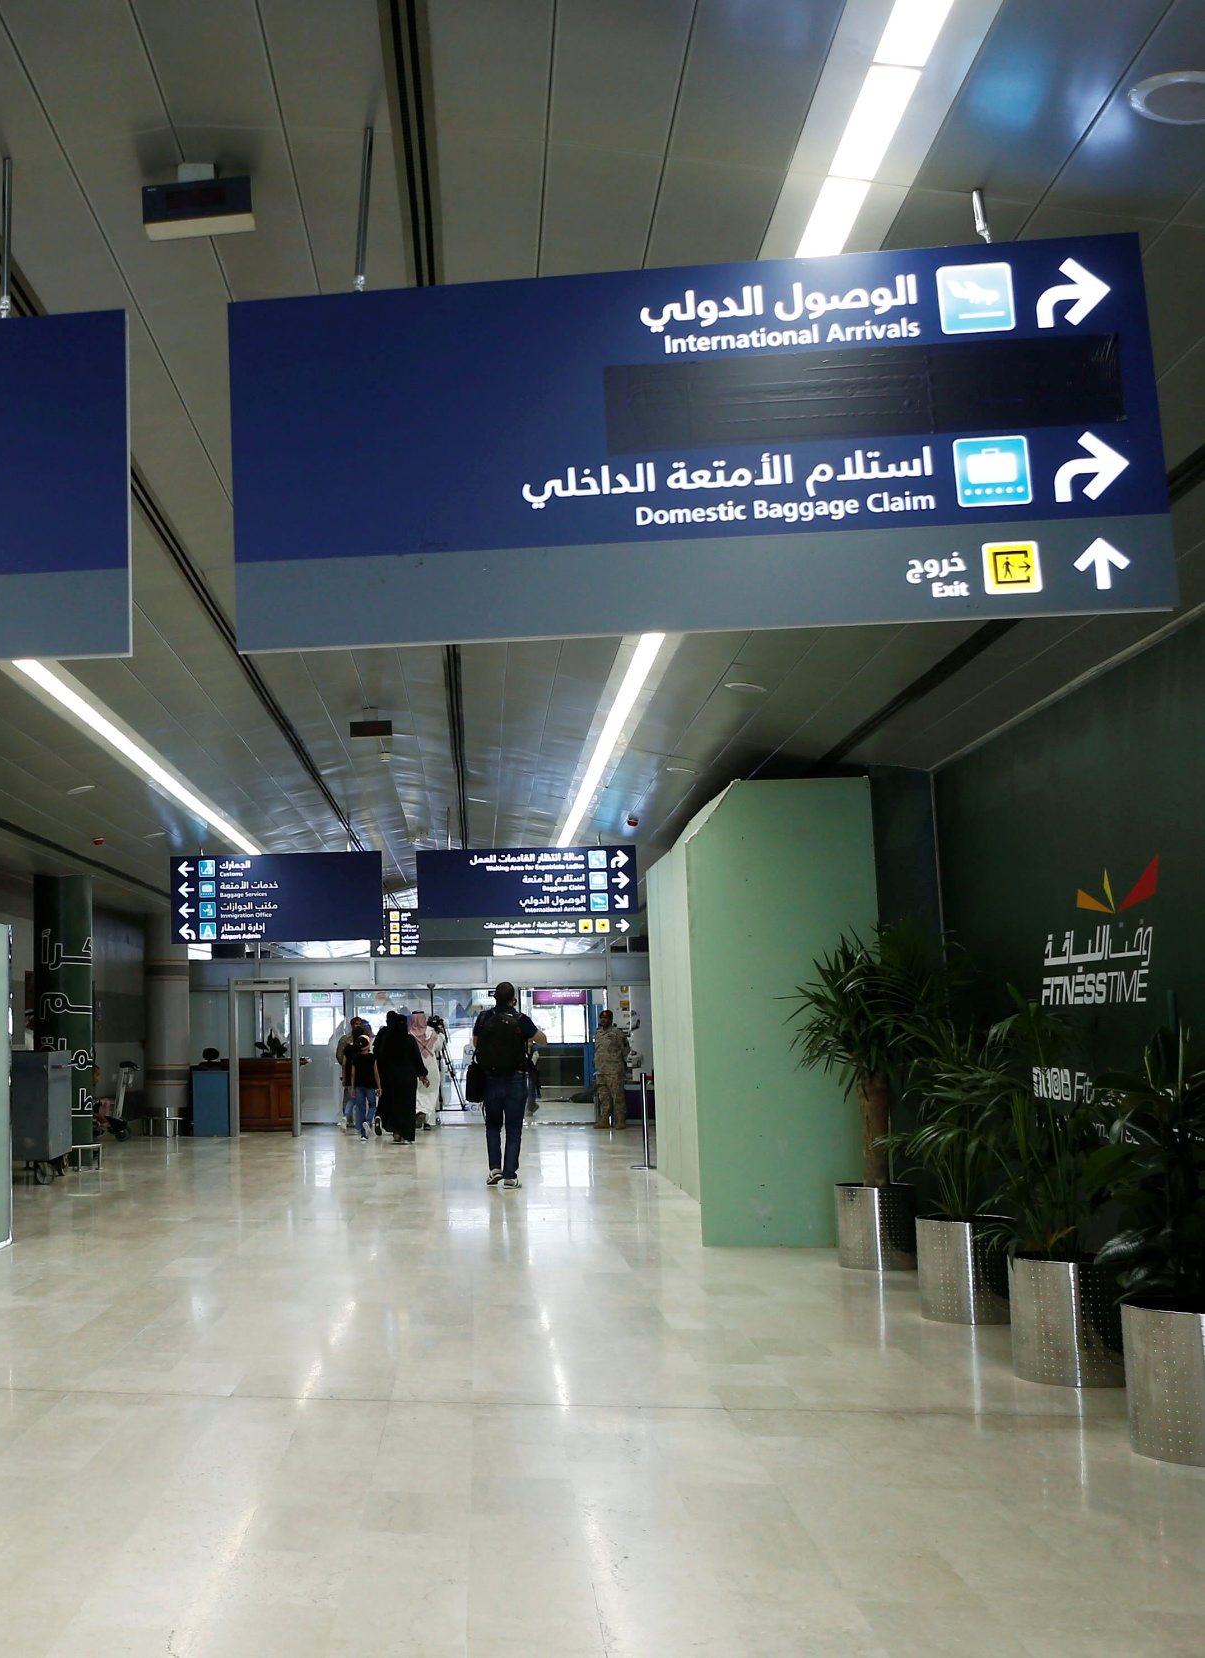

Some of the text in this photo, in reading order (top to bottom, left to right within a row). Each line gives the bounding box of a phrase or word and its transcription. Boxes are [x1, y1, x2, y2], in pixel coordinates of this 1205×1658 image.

[640, 274, 918, 331] الوصول الدولي
[662, 317, 920, 354] International Arrivals
[522, 446, 933, 510] استلام الأمتعة الداخلي
[636, 491, 935, 525] Domestic Baggage Claim
[906, 552, 967, 584] خروج
[932, 581, 970, 597] Exit
[219, 859, 252, 871] الجمارك
[485, 864, 510, 872] Waiting
[525, 863, 535, 871] for
[219, 880, 279, 890] خدمات الأمتعة
[521, 873, 586, 886] استلام الأمتعة
[541, 885, 568, 893] Baggage
[220, 901, 278, 912] مكتب الجوازات
[519, 894, 587, 908] الوصول الدولي
[220, 912, 255, 920] Immigration
[524, 906, 563, 914] International
[220, 922, 266, 934] إدارة المطار
[220, 932, 262, 941] Airport Admin
